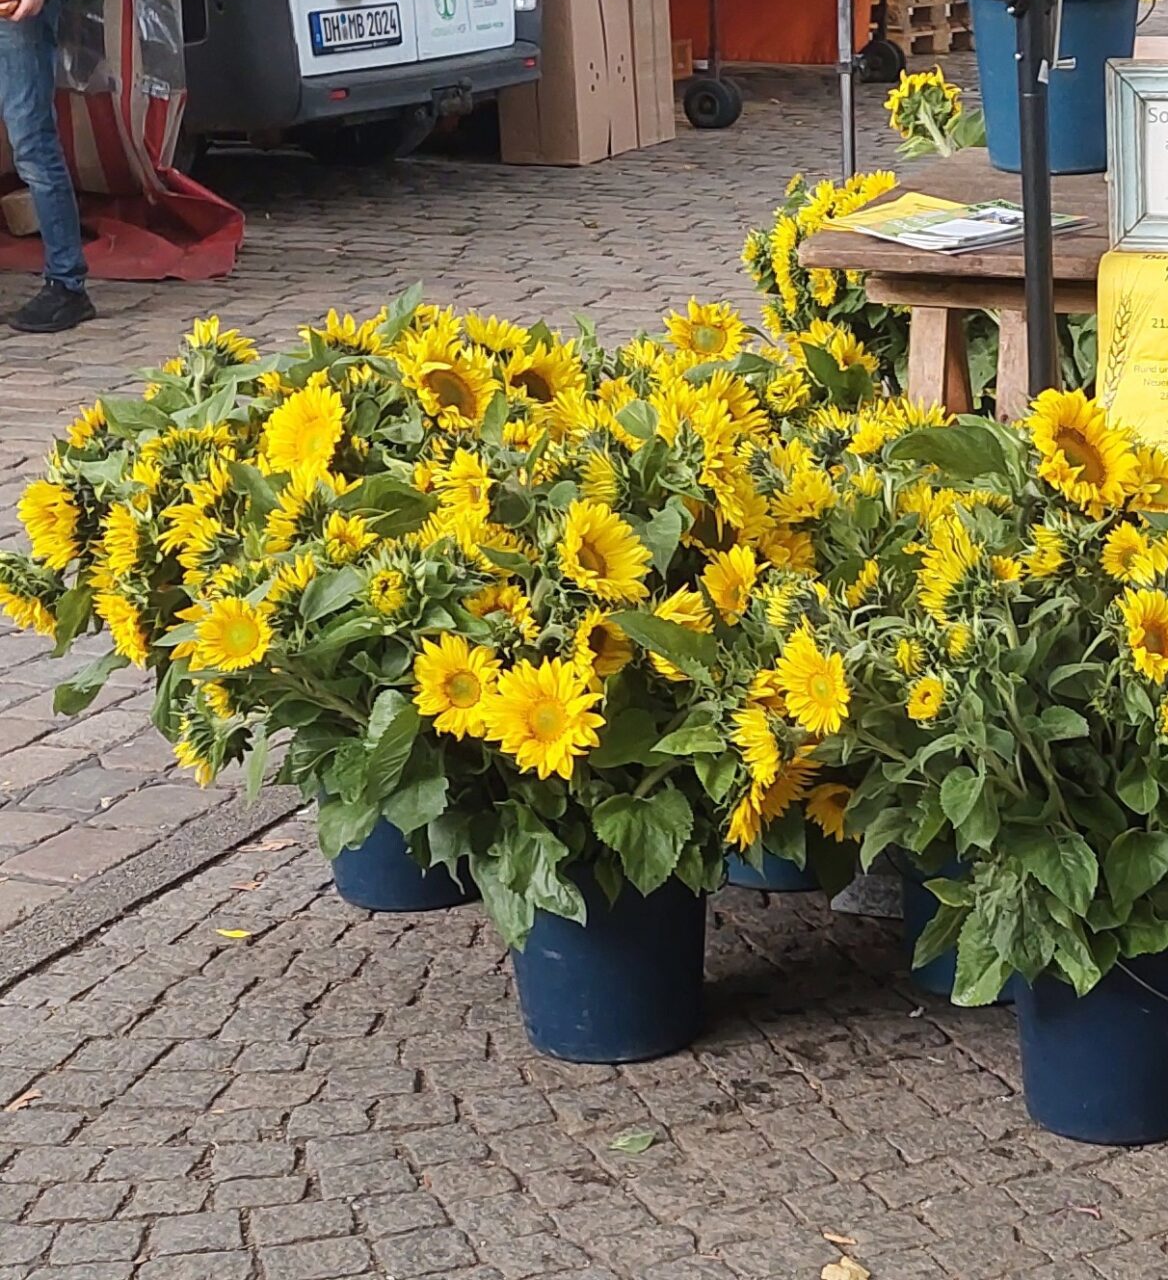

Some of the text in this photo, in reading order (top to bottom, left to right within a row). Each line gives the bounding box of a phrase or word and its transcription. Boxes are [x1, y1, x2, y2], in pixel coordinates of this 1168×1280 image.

[322, 9, 397, 43] DH MB 2024
[1151, 318, 1168, 330] 21.
